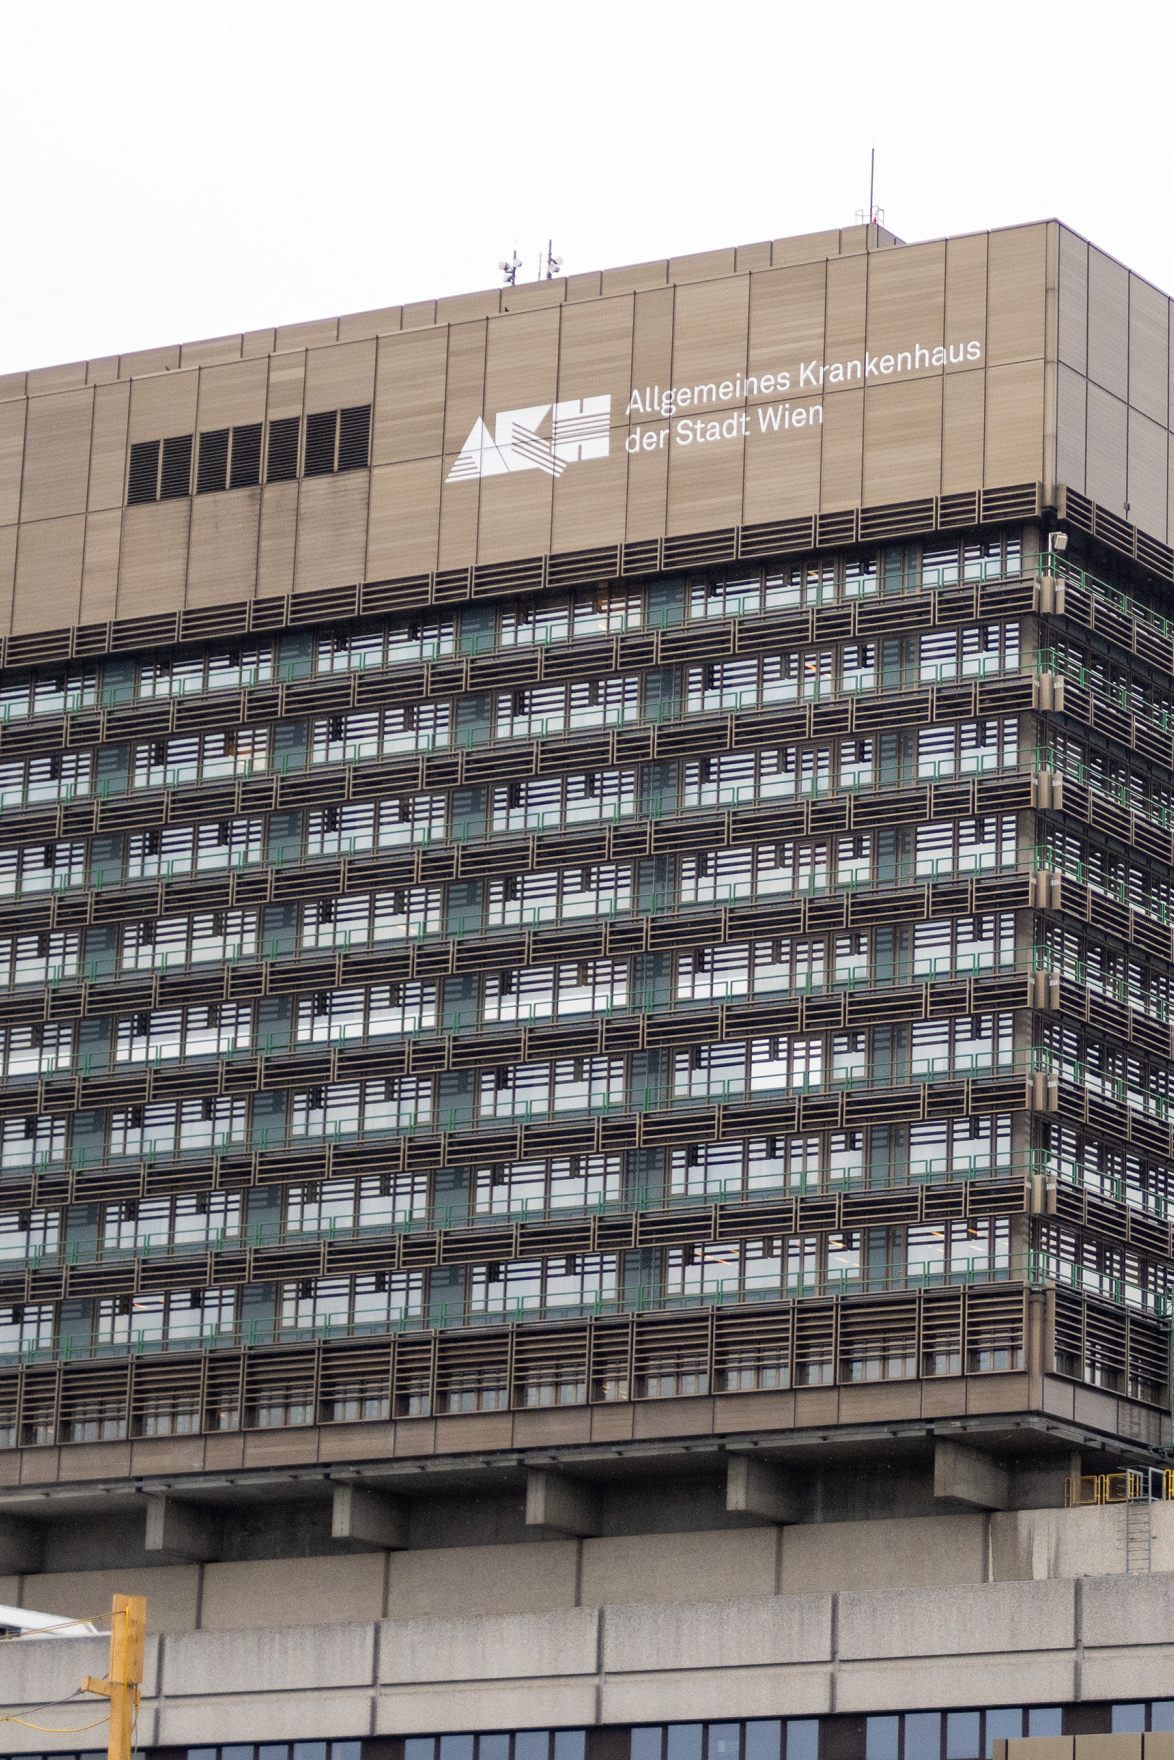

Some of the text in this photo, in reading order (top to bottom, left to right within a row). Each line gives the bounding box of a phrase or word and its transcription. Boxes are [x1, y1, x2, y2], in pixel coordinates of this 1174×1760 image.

[625, 339, 982, 418] Allgemeines Krankenhaus
[625, 401, 824, 454] der Stadt Wien
